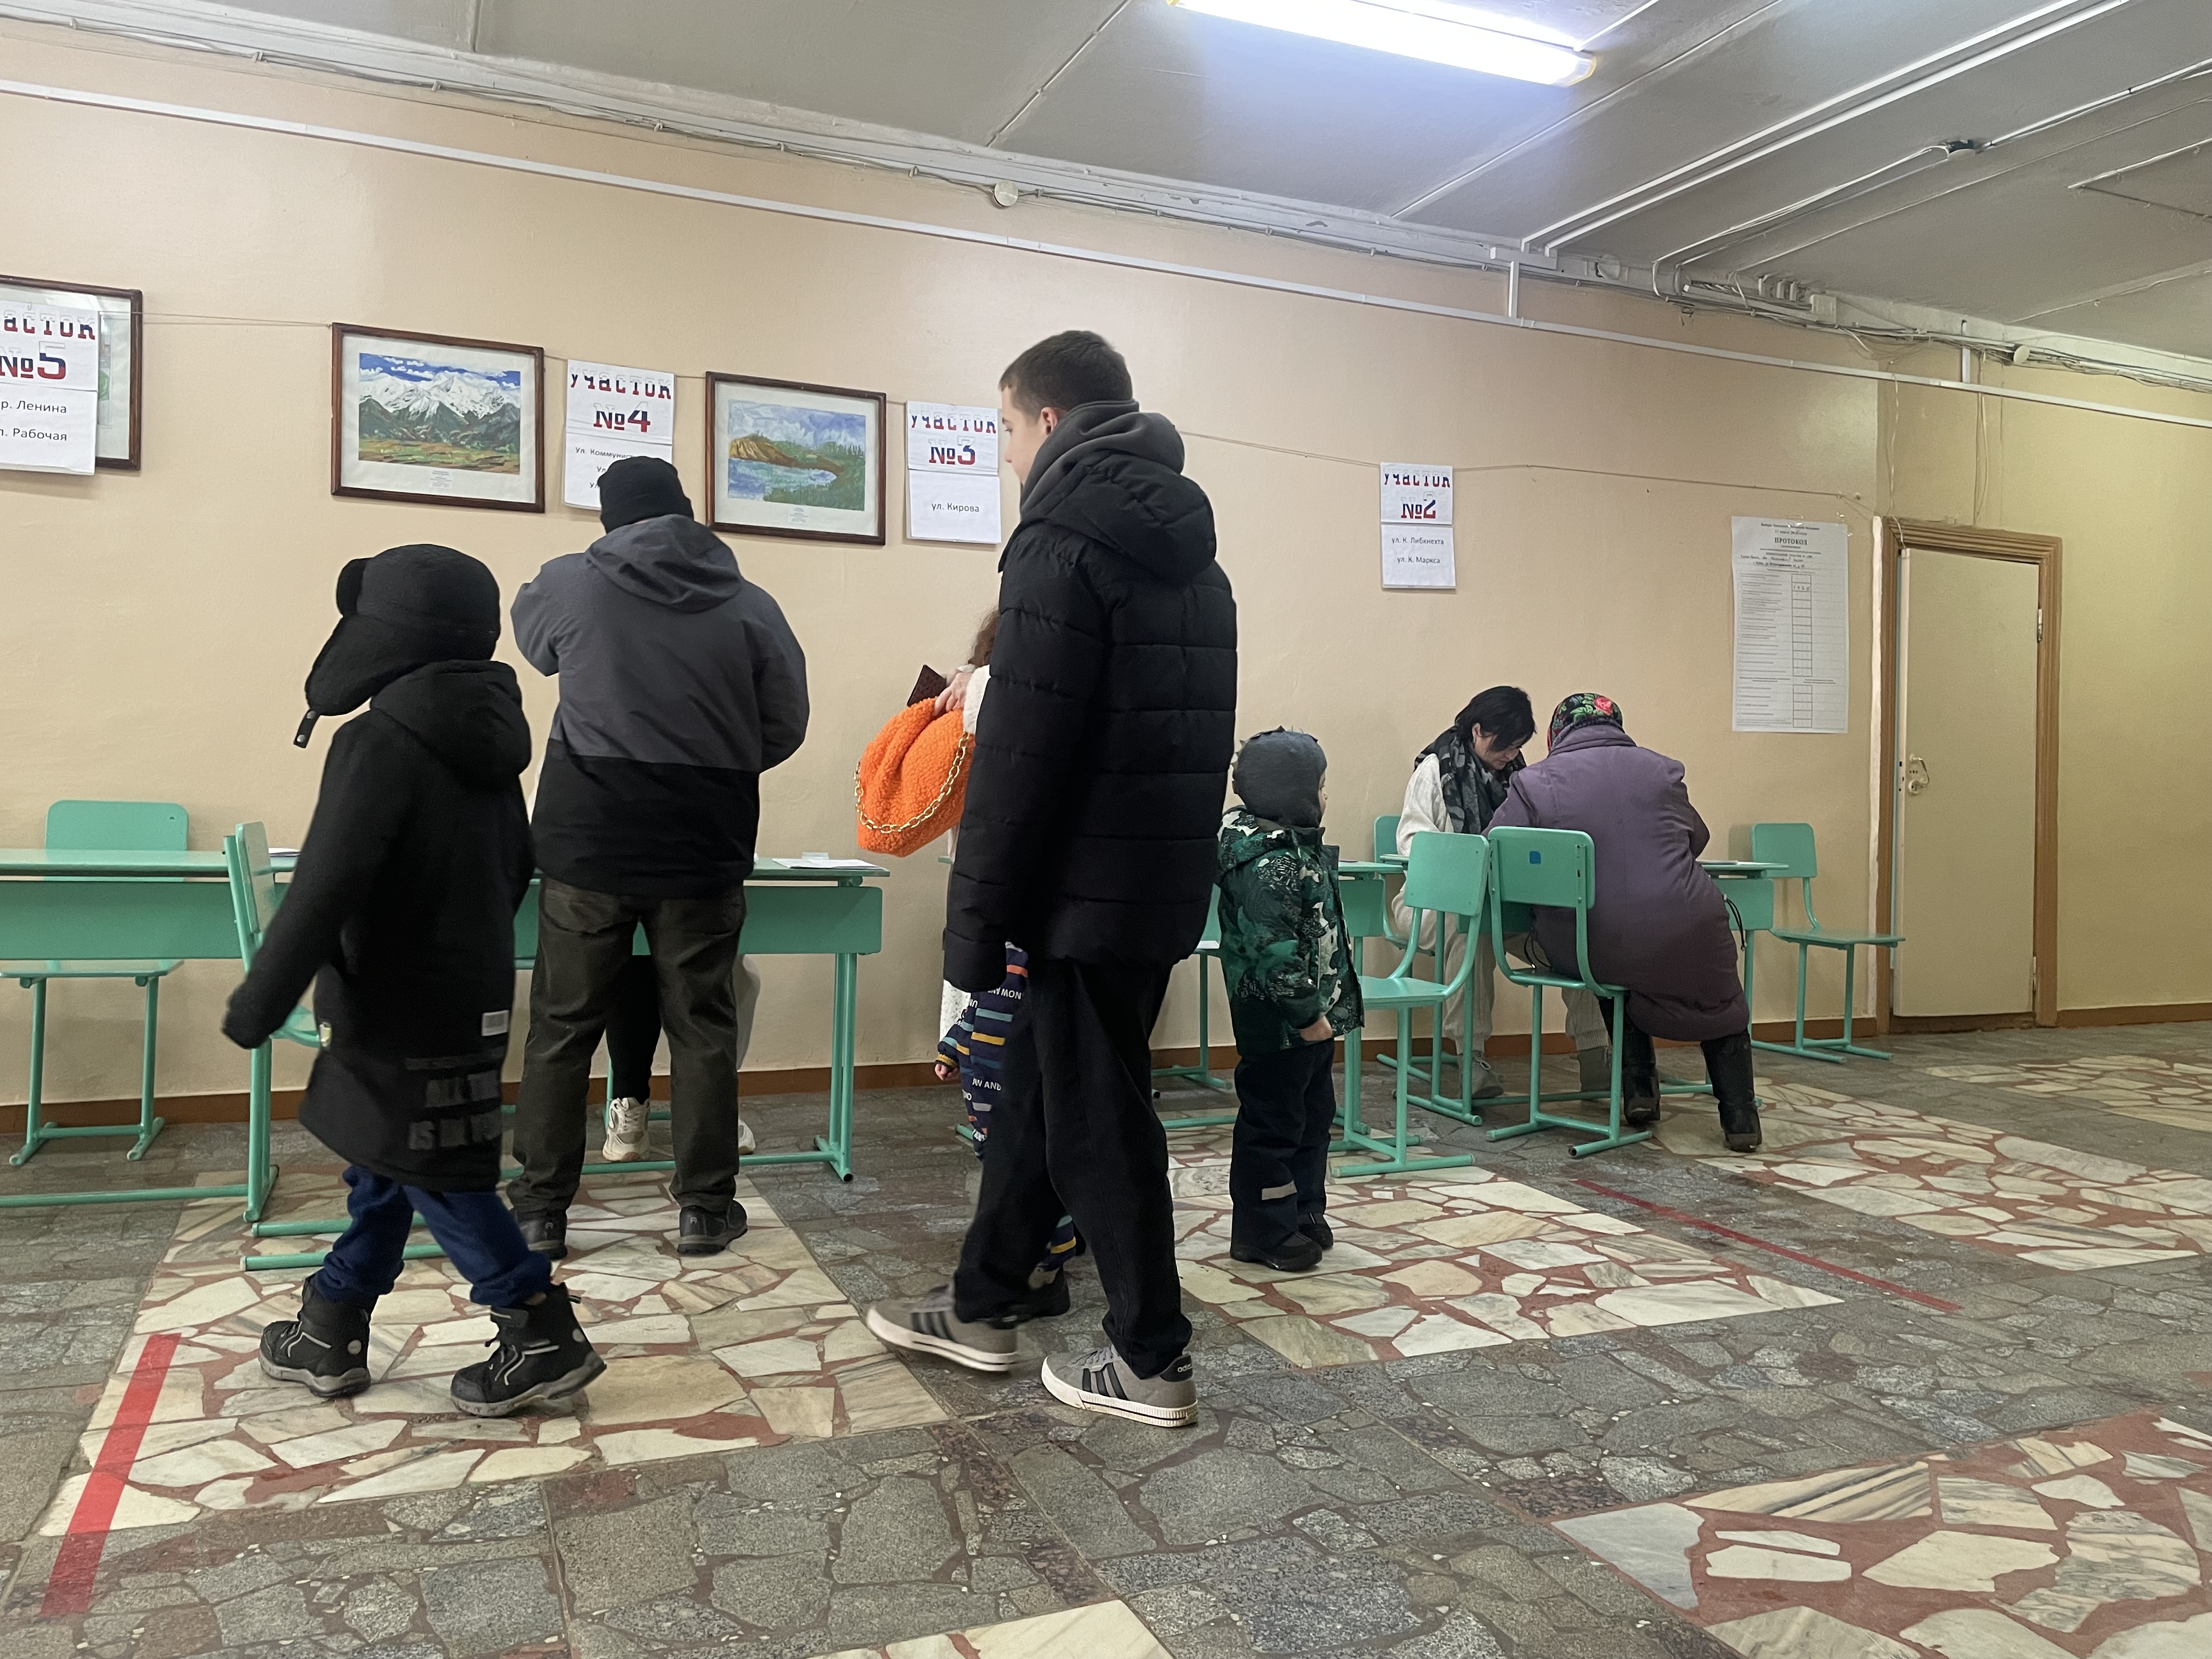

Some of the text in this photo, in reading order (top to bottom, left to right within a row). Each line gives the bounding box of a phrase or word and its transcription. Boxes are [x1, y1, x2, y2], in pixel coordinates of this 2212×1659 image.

[1, 400, 67, 414] р. Ленина
[593, 401, 651, 433] №4
[13, 428, 67, 441] Рабочая
[928, 436, 976, 465] №3
[931, 502, 979, 512] ул. Кирова
[1401, 491, 1436, 519] №2
[1774, 537, 1808, 545] ПРОТОКОЛ
[1416, 556, 1440, 565] Маркса
